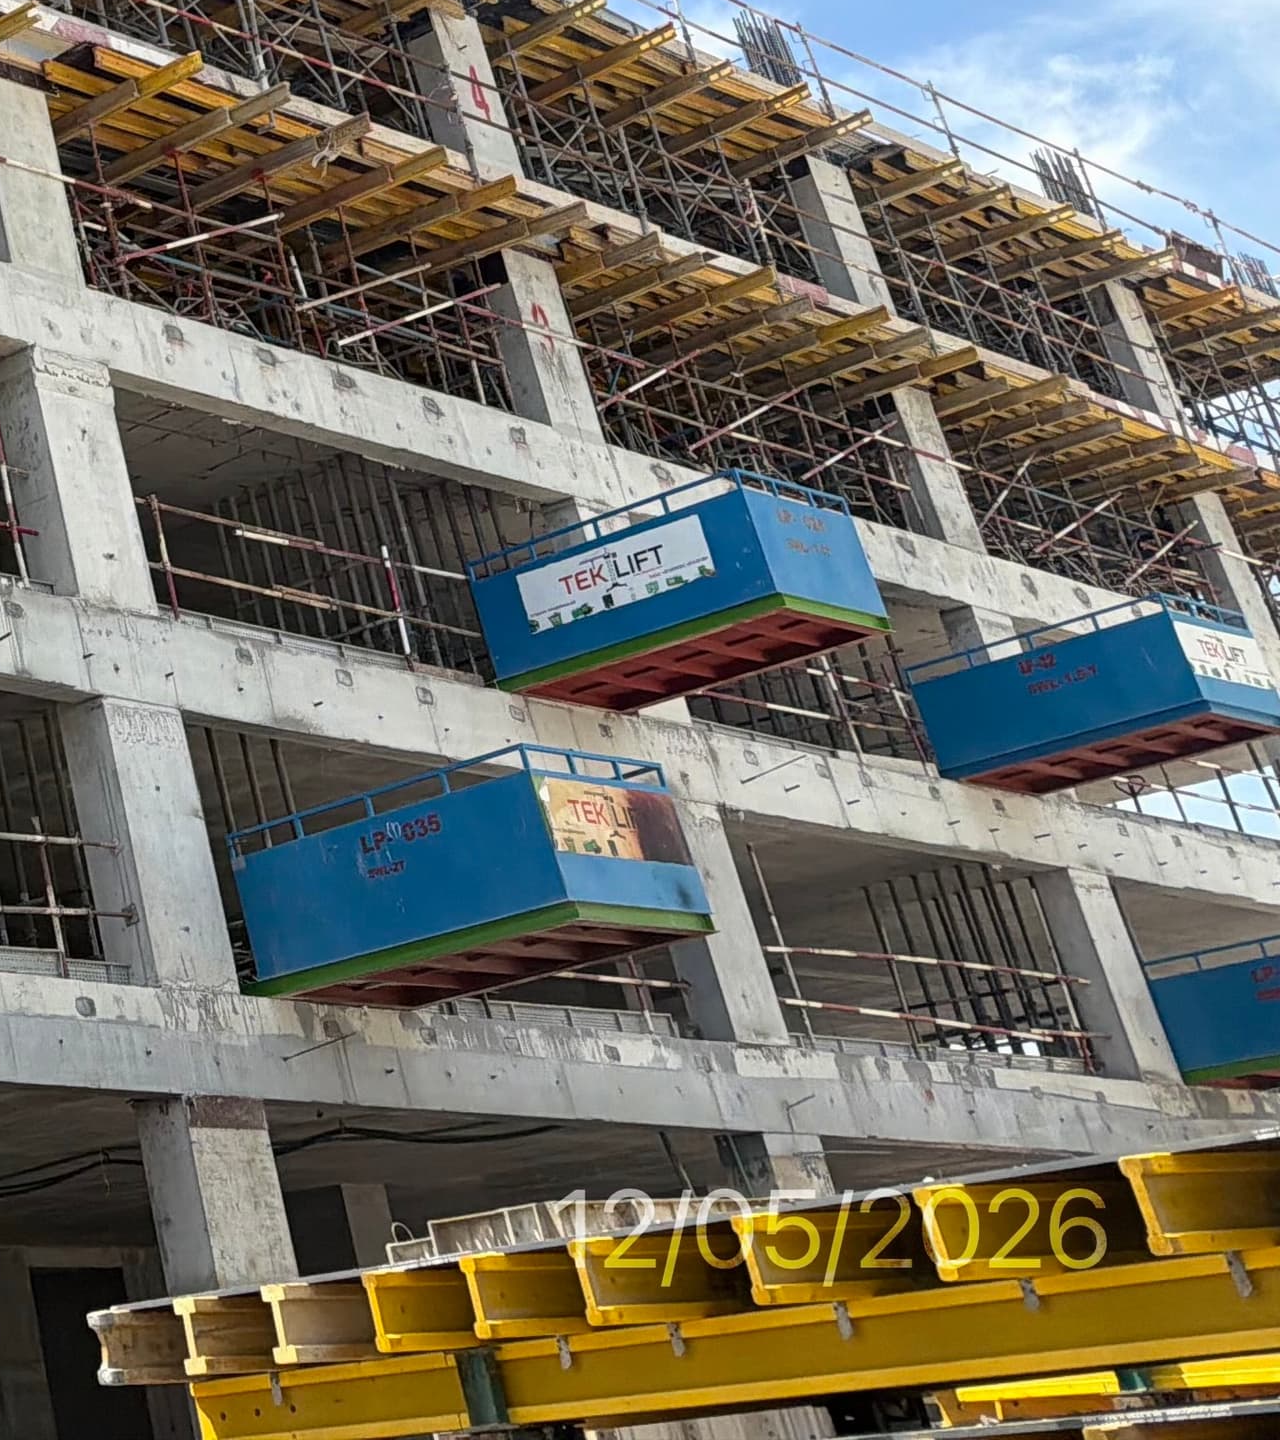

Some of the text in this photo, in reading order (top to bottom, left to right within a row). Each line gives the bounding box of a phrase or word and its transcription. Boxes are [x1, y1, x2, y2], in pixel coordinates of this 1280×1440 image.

[559, 563, 608, 595] TEK
[614, 544, 663, 578] LIFT
[567, 799, 610, 826] TEK
